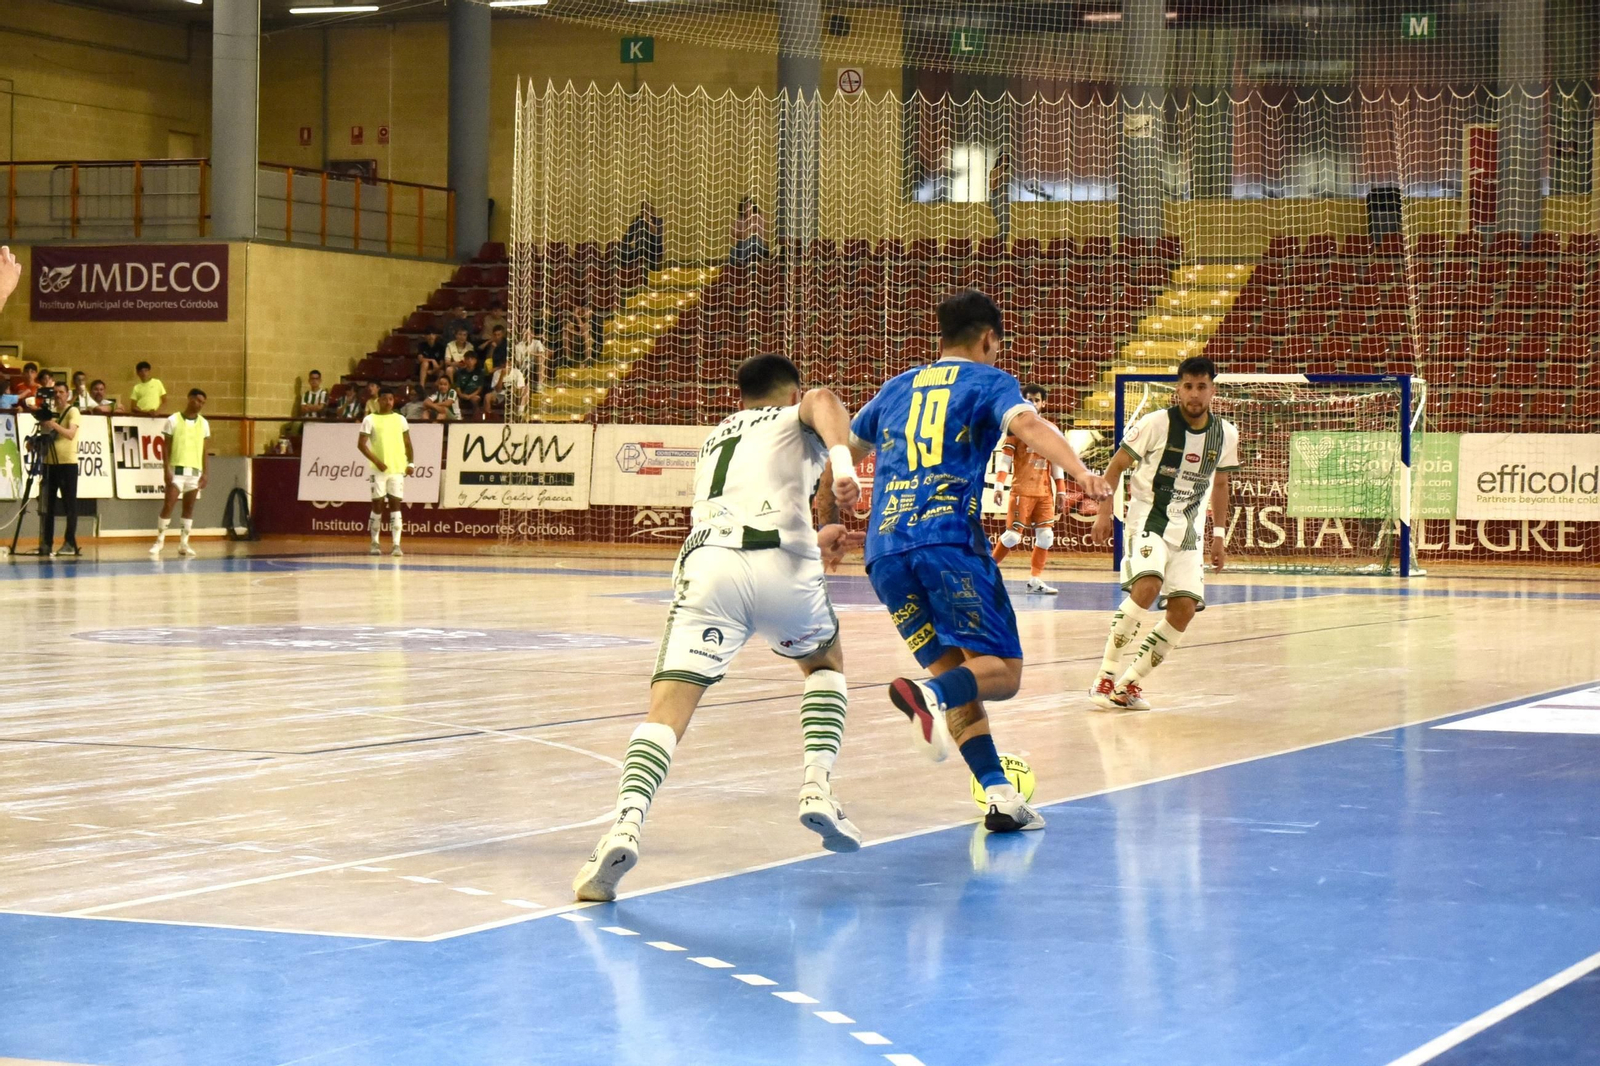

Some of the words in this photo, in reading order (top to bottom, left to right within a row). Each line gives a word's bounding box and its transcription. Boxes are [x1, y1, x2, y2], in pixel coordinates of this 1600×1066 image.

[1409, 17, 1428, 36] M
[630, 41, 643, 59] K
[961, 33, 973, 50] L
[81, 262, 221, 293] IMDECO
[39, 300, 75, 310] Instituto
[77, 300, 120, 310] Municipal
[122, 299, 134, 309] de
[136, 299, 178, 310] Deportes
[180, 299, 219, 309] Córdoba
[905, 388, 951, 472] 19
[307, 456, 364, 481] Ángela
[709, 434, 742, 501] 7
[1477, 464, 1599, 495] efficold
[1476, 494, 1516, 503] Partners
[1519, 495, 1556, 505] beyond
[1559, 495, 1574, 504] the
[1577, 495, 1598, 504] cold
[312, 518, 364, 531] Instituto
[434, 521, 450, 534] de
[454, 521, 514, 537] Deportes
[518, 521, 575, 536] Córdoba
